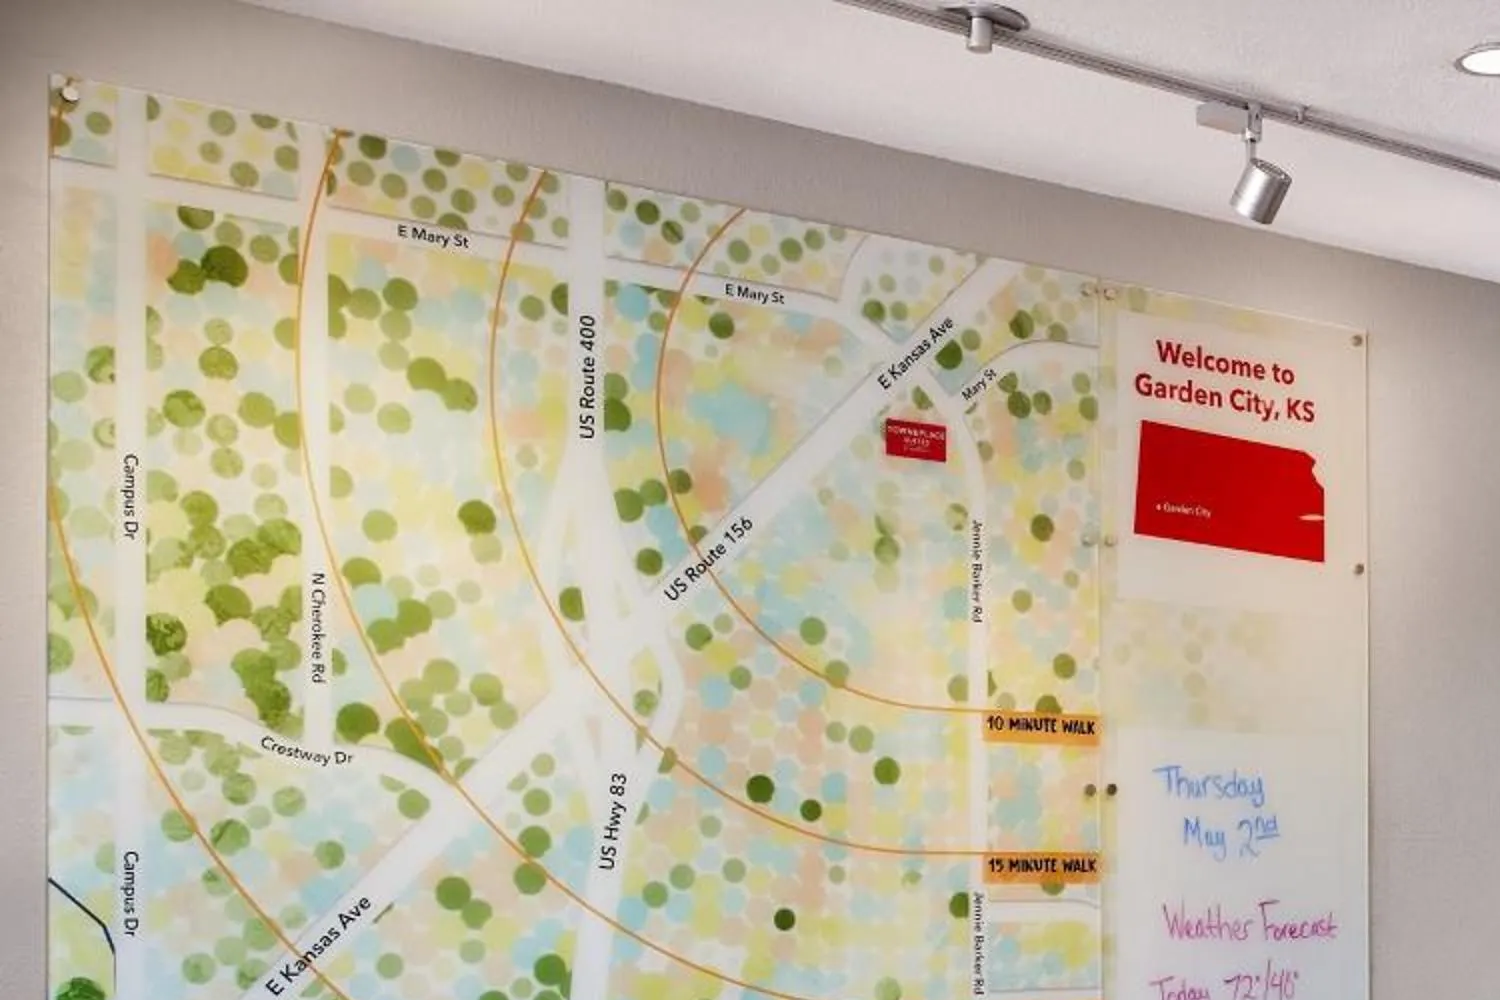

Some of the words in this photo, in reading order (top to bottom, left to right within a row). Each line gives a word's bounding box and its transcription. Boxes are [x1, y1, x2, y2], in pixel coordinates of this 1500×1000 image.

[397, 223, 408, 238] E
[411, 227, 450, 248] Mary
[453, 234, 469, 248] St
[725, 283, 734, 296] E
[737, 285, 769, 305] Mary
[772, 292, 785, 304] St
[579, 315, 595, 351] 400
[877, 373, 892, 390] E
[887, 339, 932, 381] Kansas
[929, 317, 954, 343] Ave
[1156, 339, 1266, 380] Welcome
[1272, 363, 1296, 385] to
[579, 356, 595, 409] Route
[961, 378, 988, 400] Mary
[983, 368, 998, 381] St
[1135, 373, 1223, 408] Garden
[1229, 388, 1281, 422] City,
[1287, 397, 1315, 423] KS
[579, 413, 595, 439] US
[120, 453, 139, 517] Campus
[124, 521, 139, 540] Dr
[663, 577, 689, 601] US
[684, 543, 727, 583] Route
[723, 516, 754, 544] 156
[311, 573, 325, 586] N
[972, 563, 983, 602] Barker
[311, 589, 327, 660] Cherokee
[972, 606, 983, 623] Rd
[311, 663, 327, 684] Rd
[987, 715, 1005, 731] 10
[1009, 717, 1057, 733] MINUTE
[1062, 719, 1096, 735] WALK
[261, 736, 331, 767] Crestway
[334, 751, 353, 765] Dr
[609, 773, 627, 797] 83
[1152, 765, 1264, 808] Thursday
[603, 801, 627, 841] Hwy
[1183, 815, 1226, 862] May
[598, 845, 617, 870] US
[988, 857, 1005, 873] 15
[1009, 857, 1057, 873] MINUTE
[1062, 858, 1097, 873] WALK
[120, 851, 139, 915] Campus
[124, 918, 139, 937] Dr
[1163, 900, 1254, 941] Weather
[1258, 899, 1338, 941] Forecast
[265, 979, 285, 997] E
[279, 926, 342, 984] Kansas
[338, 897, 372, 931] Ave
[973, 978, 984, 995] Rd
